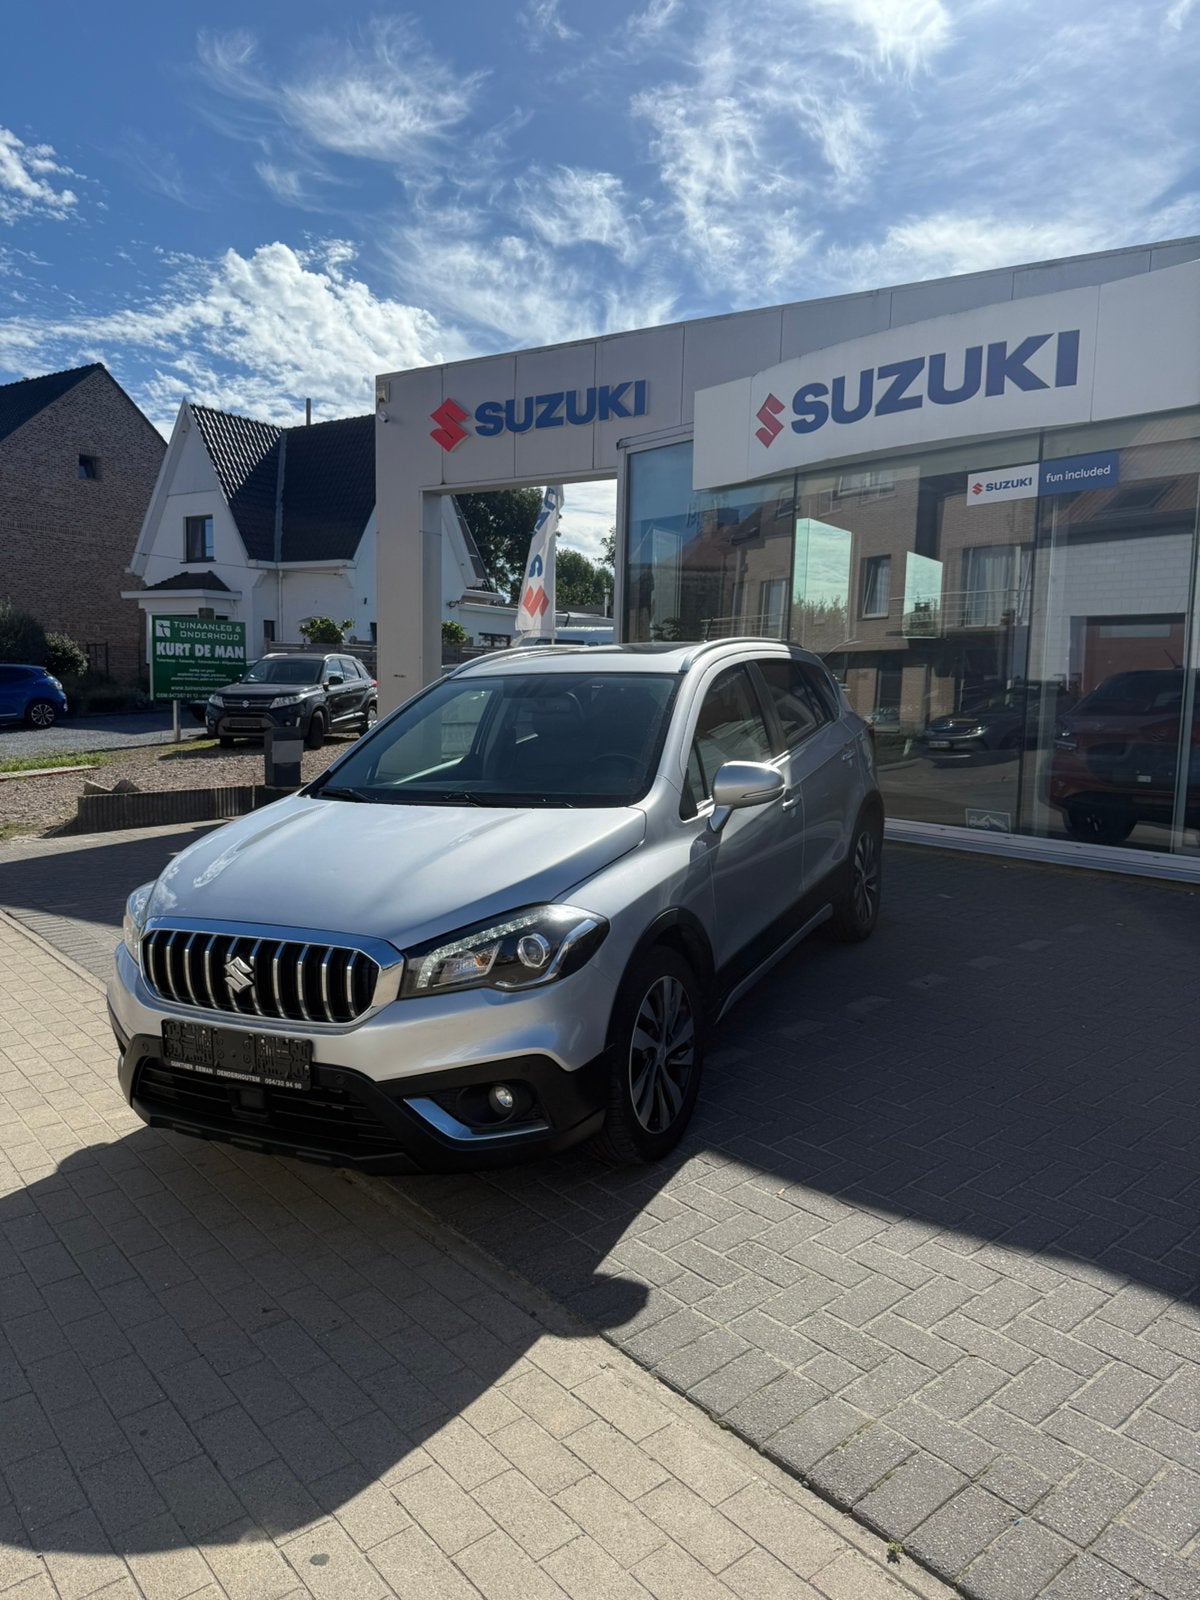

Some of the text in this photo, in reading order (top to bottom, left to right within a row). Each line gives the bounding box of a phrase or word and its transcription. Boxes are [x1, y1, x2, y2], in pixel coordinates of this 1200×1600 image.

[791, 329, 1080, 434] SUZUKI
[474, 379, 646, 437] SUZUKI
[1046, 465, 1111, 483] fun included
[985, 477, 1033, 492] SUZUKI
[173, 621, 232, 632] TUINAANLEG
[180, 630, 239, 641] ONDERHOUD
[156, 641, 244, 659] KURT DE MAN
[216, 1069, 261, 1083] DENDERHOUTEM
